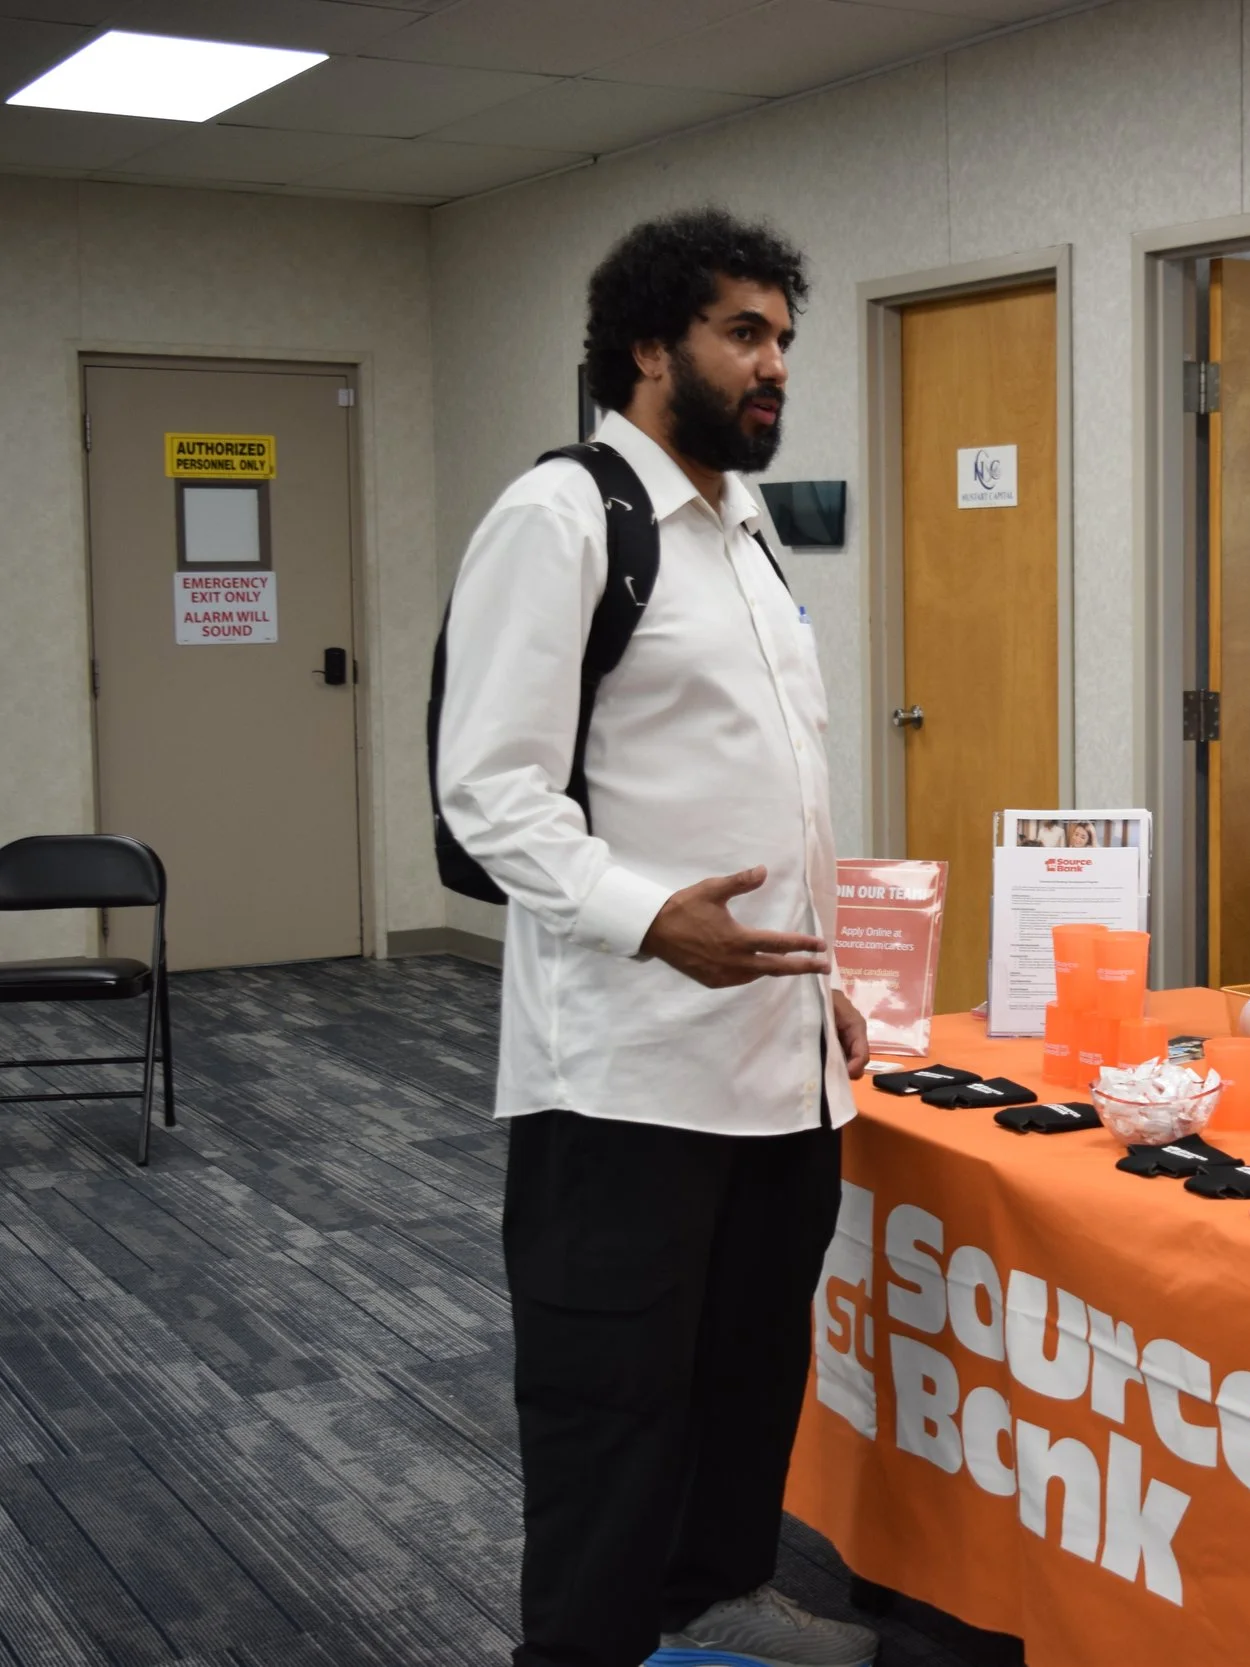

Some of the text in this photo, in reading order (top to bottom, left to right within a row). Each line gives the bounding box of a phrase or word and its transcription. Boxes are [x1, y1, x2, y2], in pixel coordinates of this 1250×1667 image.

[176, 442, 266, 456] AUTHORIZED
[176, 459, 266, 471] PERSONNEL ONLY
[182, 577, 268, 589] EMERGENCY
[191, 591, 261, 603] EXIT ONLY
[184, 611, 270, 623] ALARM WILL
[202, 625, 253, 637] SOUND
[1057, 858, 1092, 866] Source
[836, 884, 855, 898] OIN
[858, 885, 886, 899] OUR
[841, 926, 903, 938] Apply Online at
[889, 1332, 1192, 1608] Bank
